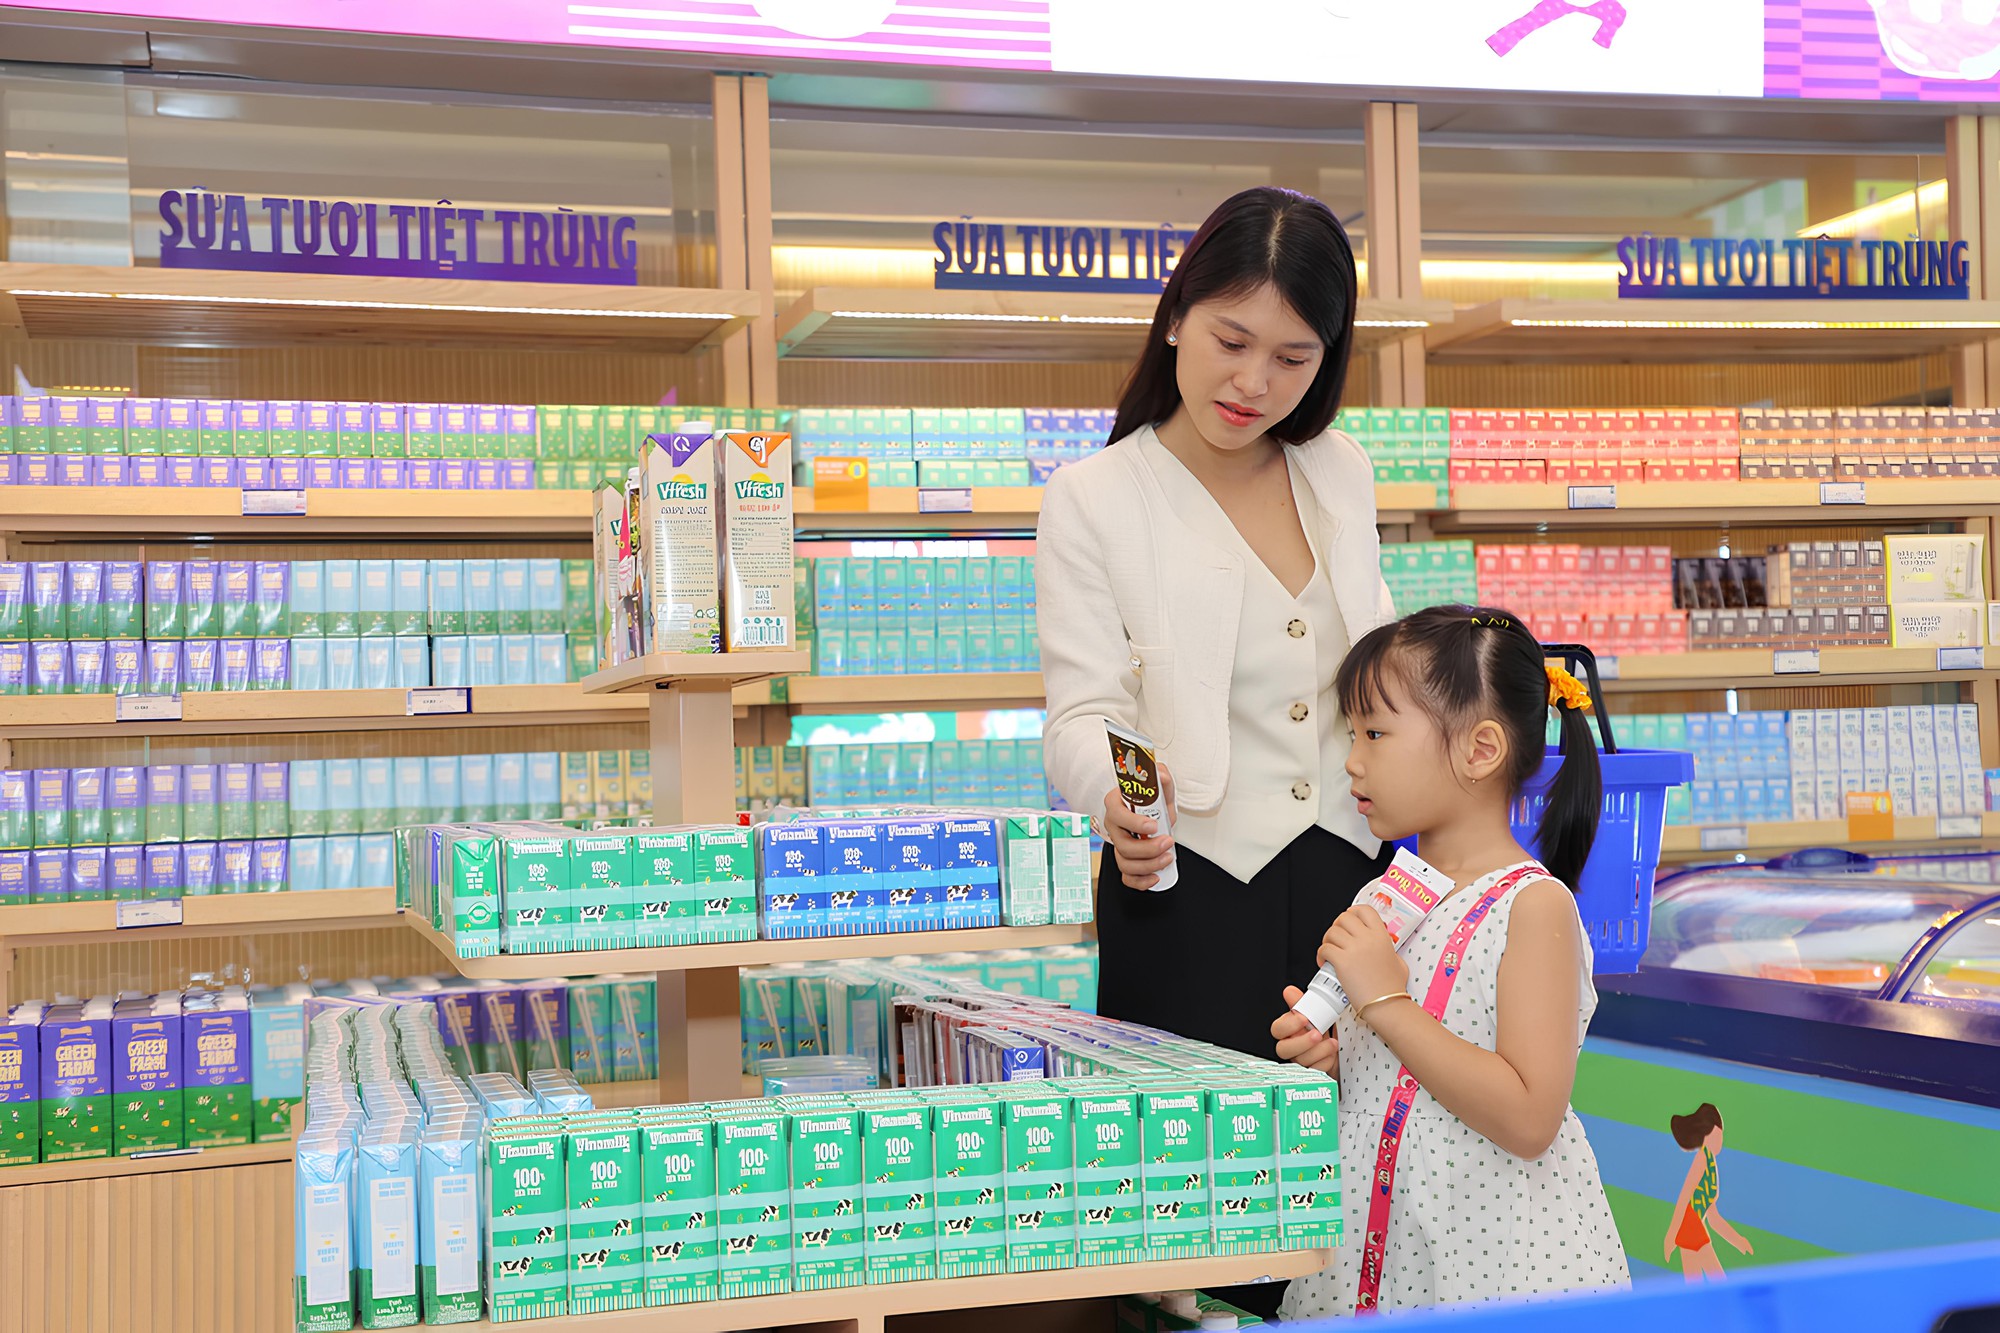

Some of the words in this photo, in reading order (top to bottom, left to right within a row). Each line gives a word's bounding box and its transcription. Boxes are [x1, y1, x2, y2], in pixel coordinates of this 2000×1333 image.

[159, 185, 251, 249] SỮA
[262, 197, 378, 257] TƯƠI
[389, 199, 484, 271] TIỆT
[494, 206, 637, 269] TRÙNG
[933, 215, 1008, 274] SỮA
[1016, 224, 1110, 278] TƯƠI
[1617, 231, 1685, 286] SỮA
[1690, 237, 1775, 286] TƯƠI
[1782, 233, 1853, 294] TIỆT
[1861, 233, 1970, 287] TRÙNG
